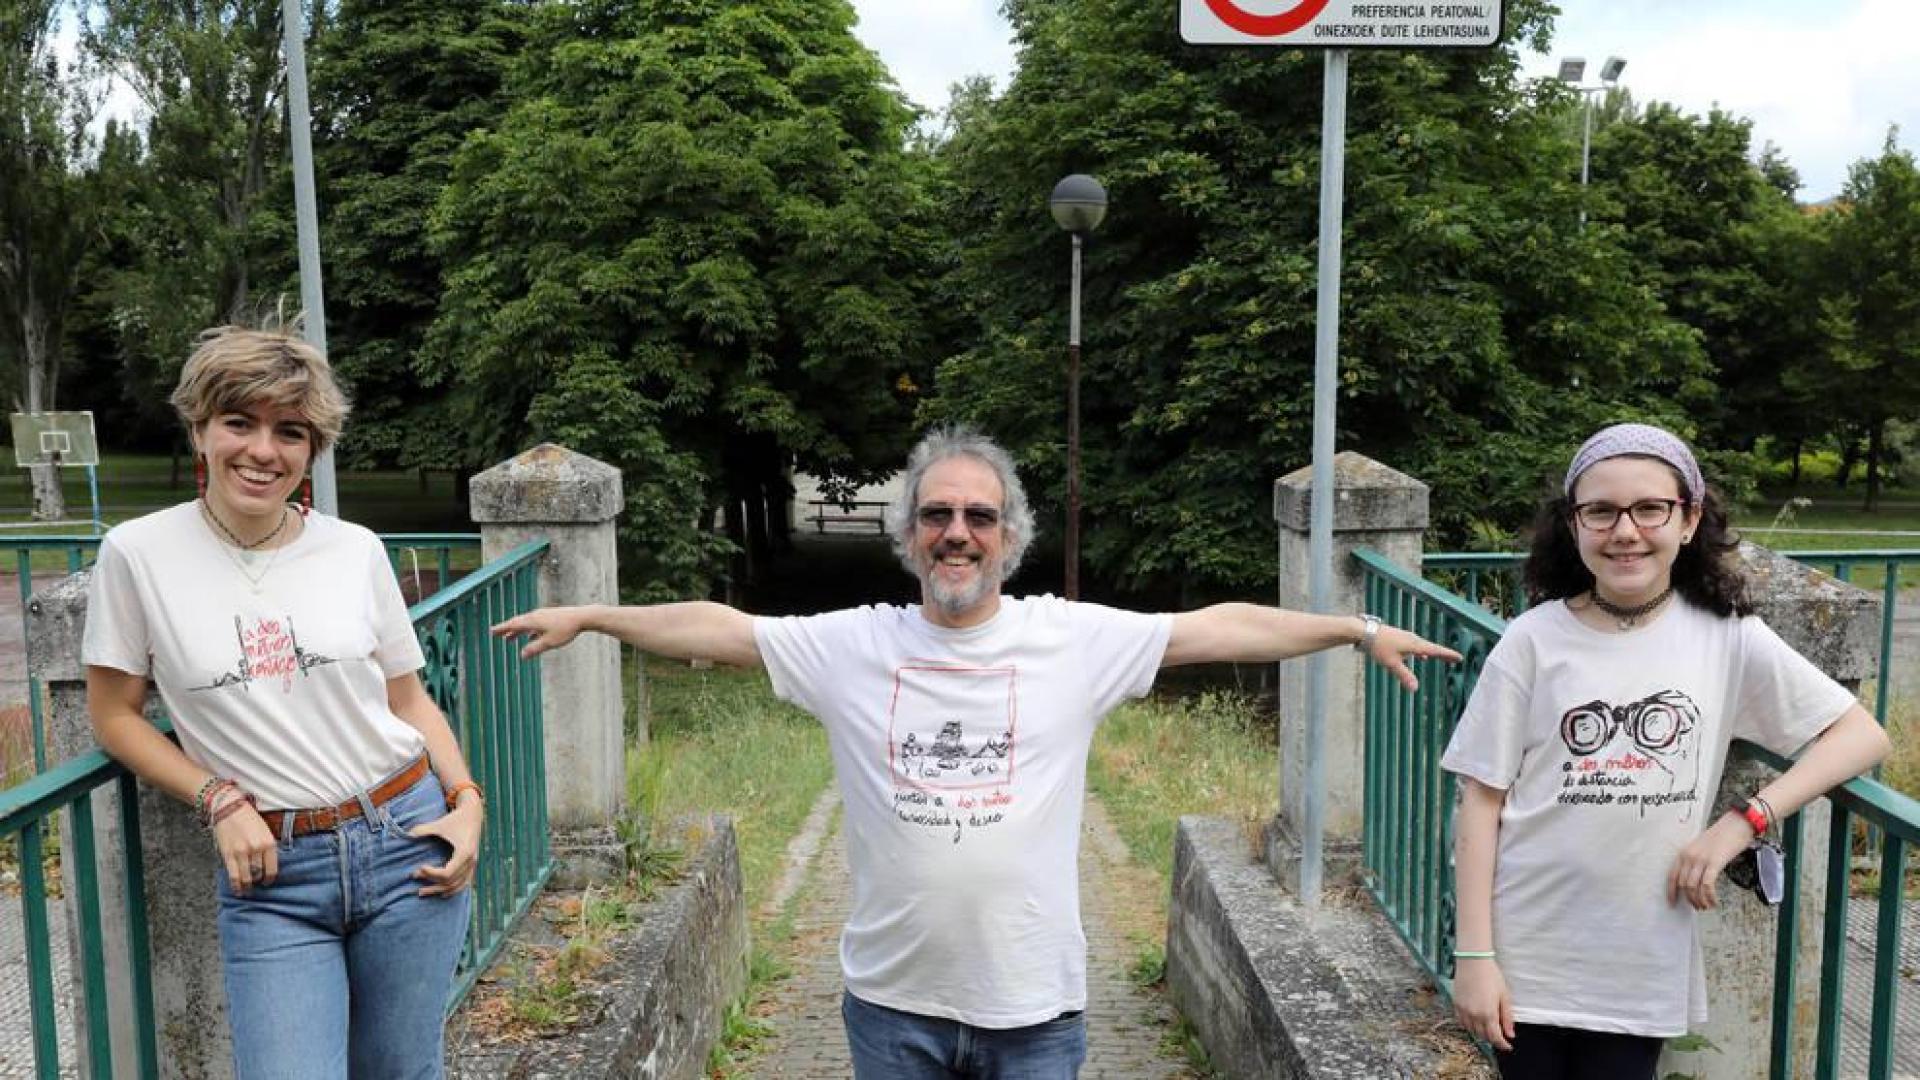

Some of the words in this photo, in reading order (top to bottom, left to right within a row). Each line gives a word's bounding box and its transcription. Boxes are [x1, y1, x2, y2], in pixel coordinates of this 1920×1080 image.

[1351, 5, 1426, 18] PREFERENCIA
[1314, 24, 1376, 38] OINEZKOEK
[1381, 24, 1410, 38] DUTE
[1413, 24, 1490, 38] LEHENTASUNA
[1562, 761, 1573, 772] a
[953, 819, 961, 844] y
